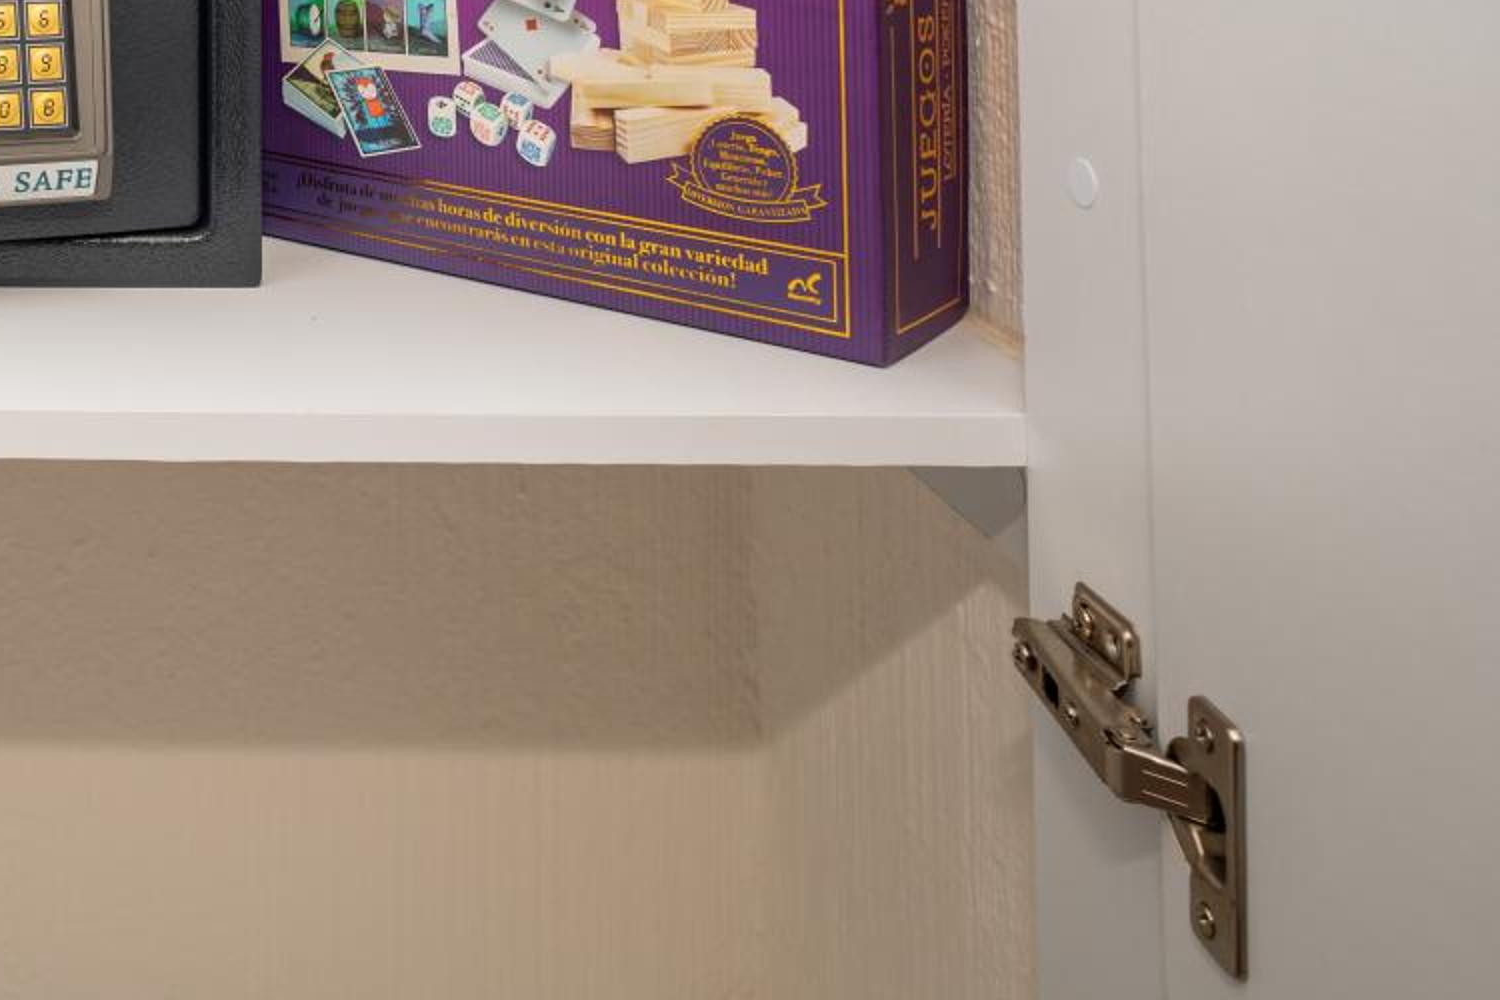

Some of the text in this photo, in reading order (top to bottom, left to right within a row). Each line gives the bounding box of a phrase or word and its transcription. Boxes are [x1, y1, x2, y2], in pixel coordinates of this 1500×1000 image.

[39, 10, 49, 28] 6
[41, 54, 52, 72] 9
[917, 14, 938, 231] JUEGOS
[14, 167, 94, 194] SAFE
[439, 199, 481, 220] horas
[483, 208, 502, 224] de
[505, 211, 582, 240] diversión
[585, 228, 616, 246] con
[619, 231, 635, 250] la
[639, 240, 681, 259] gran
[685, 247, 769, 276] variedad
[510, 234, 531, 248] en
[536, 240, 565, 254] esta
[567, 243, 639, 267] original
[642, 259, 737, 288] colección!
